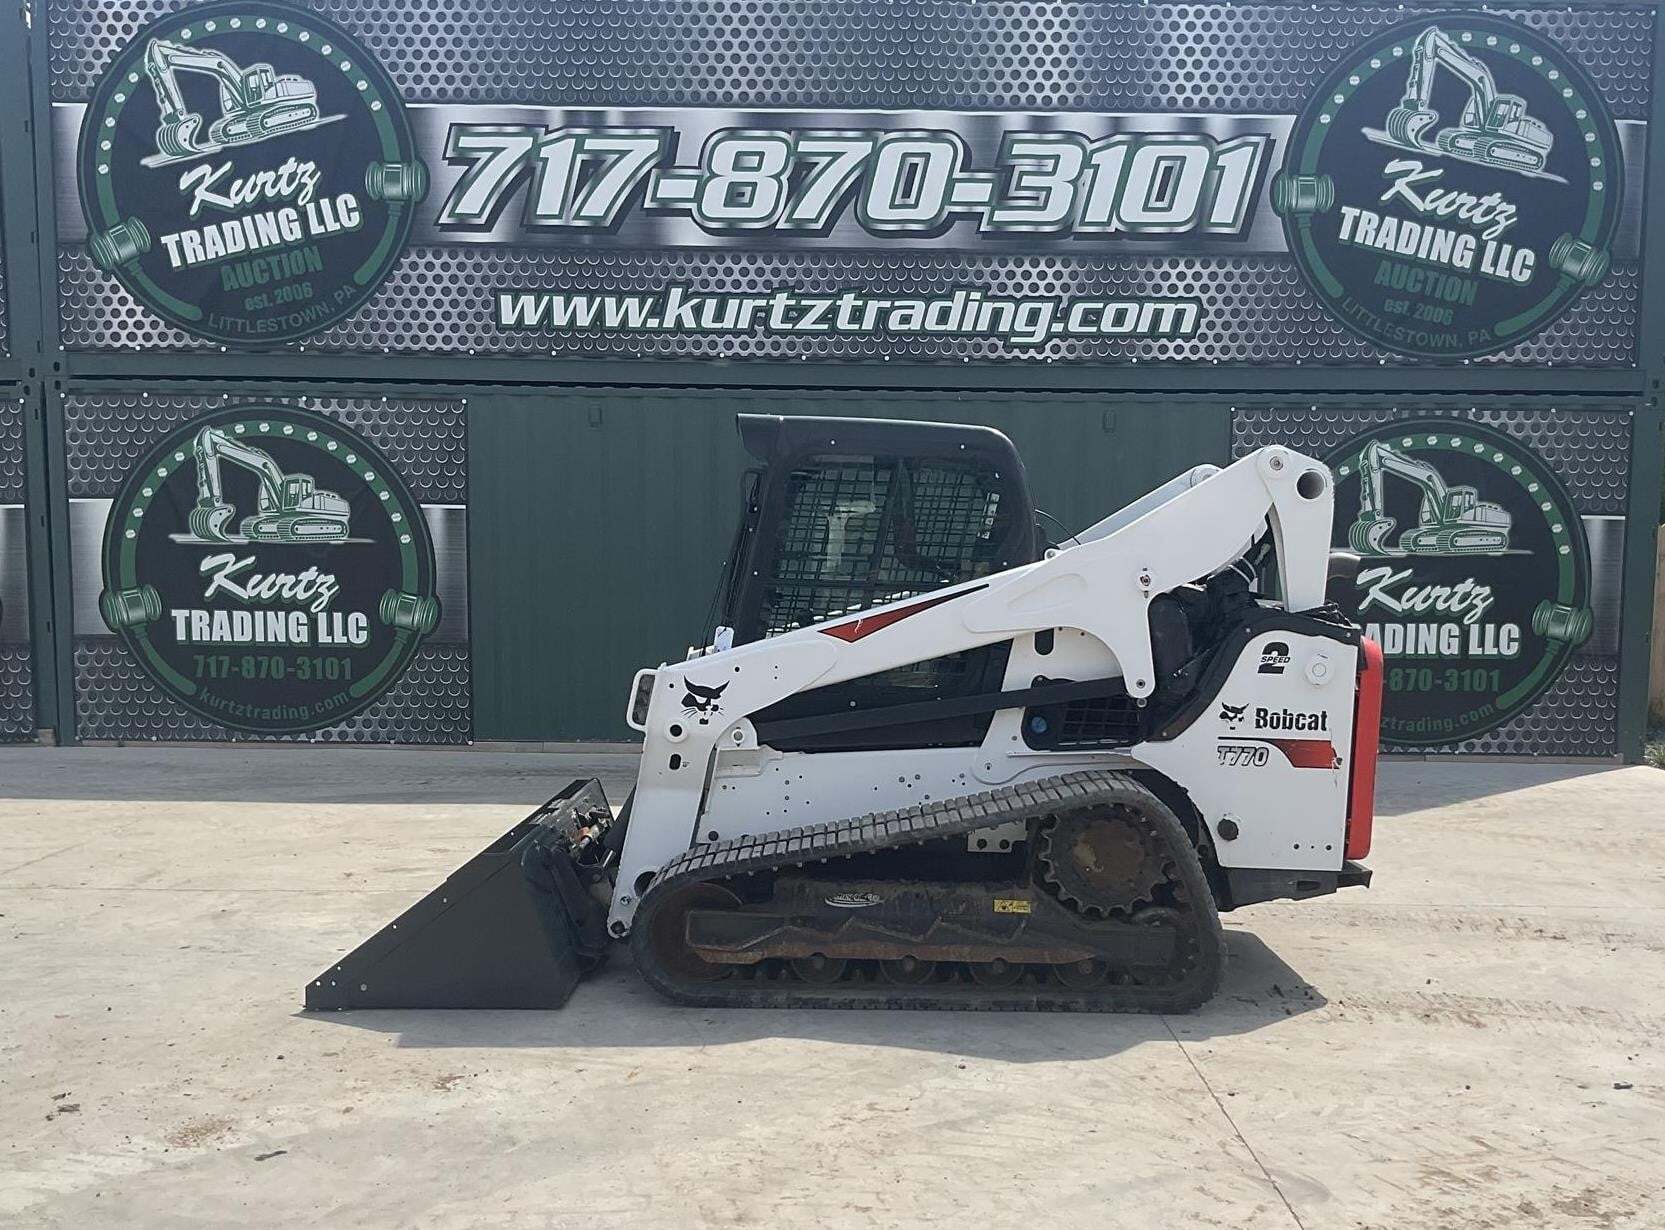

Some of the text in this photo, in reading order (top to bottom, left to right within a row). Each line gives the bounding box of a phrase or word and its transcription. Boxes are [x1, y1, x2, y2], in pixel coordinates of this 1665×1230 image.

[179, 157, 320, 216] Kurtz
[444, 127, 1262, 232] 717-870-3101
[1381, 159, 1517, 239] Kurtz
[161, 193, 360, 267] TRADING LLC
[1338, 206, 1534, 282] TRADING LLC
[221, 246, 323, 291] AUCTION
[1374, 260, 1478, 305] AUCTION
[274, 282, 313, 304] 2006
[334, 284, 357, 305] PA
[500, 286, 1200, 344] www.kurtztrading.com
[1413, 303, 1454, 326] 2006
[1468, 329, 1491, 345] PA
[200, 553, 339, 612] Kurtz
[1356, 566, 1493, 625] Kurtz
[171, 609, 369, 644] TRADING LLC
[1365, 623, 1519, 655] ADING LLC
[193, 655, 353, 680] 717-870-3101
[1257, 641, 1291, 675] 2
[1260, 655, 1291, 664] SPEED
[1383, 668, 1500, 692] -870-3101
[200, 687, 349, 720] kurtztrading.com
[1254, 707, 1328, 731] Bobcat
[1381, 703, 1494, 733] ztrading.com
[1217, 745, 1269, 767] T770
